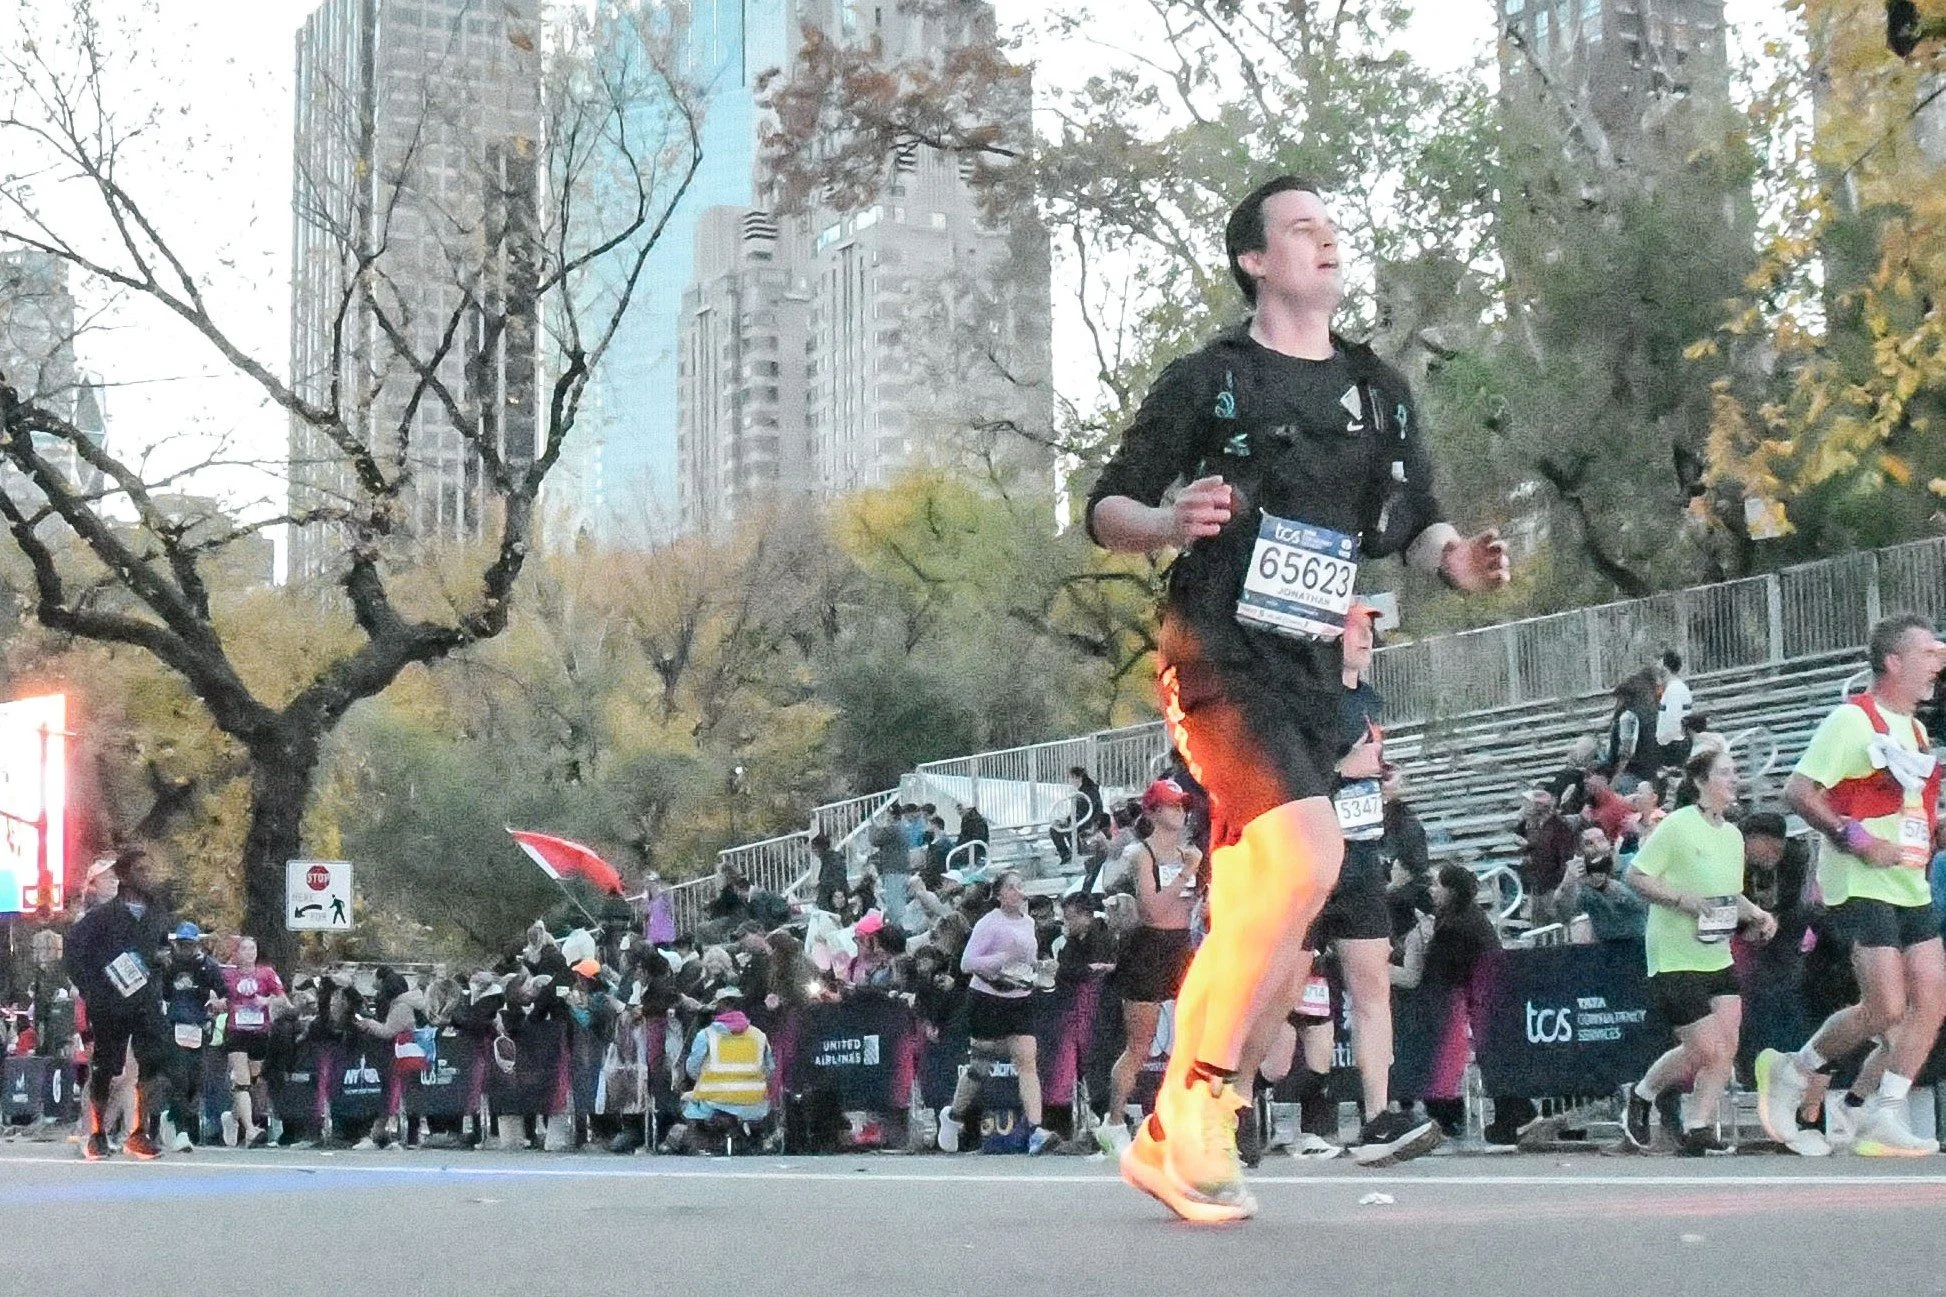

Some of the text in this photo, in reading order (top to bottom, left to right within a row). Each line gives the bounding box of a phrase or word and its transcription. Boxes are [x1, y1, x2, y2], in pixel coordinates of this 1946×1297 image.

[1275, 522, 1301, 544] tcs
[1259, 546, 1351, 598] 65623
[307, 872, 330, 884] STOP
[1526, 1001, 1573, 1043] tcs
[823, 1039, 861, 1052] UNITED
[815, 1052, 861, 1066] AIRLINES
